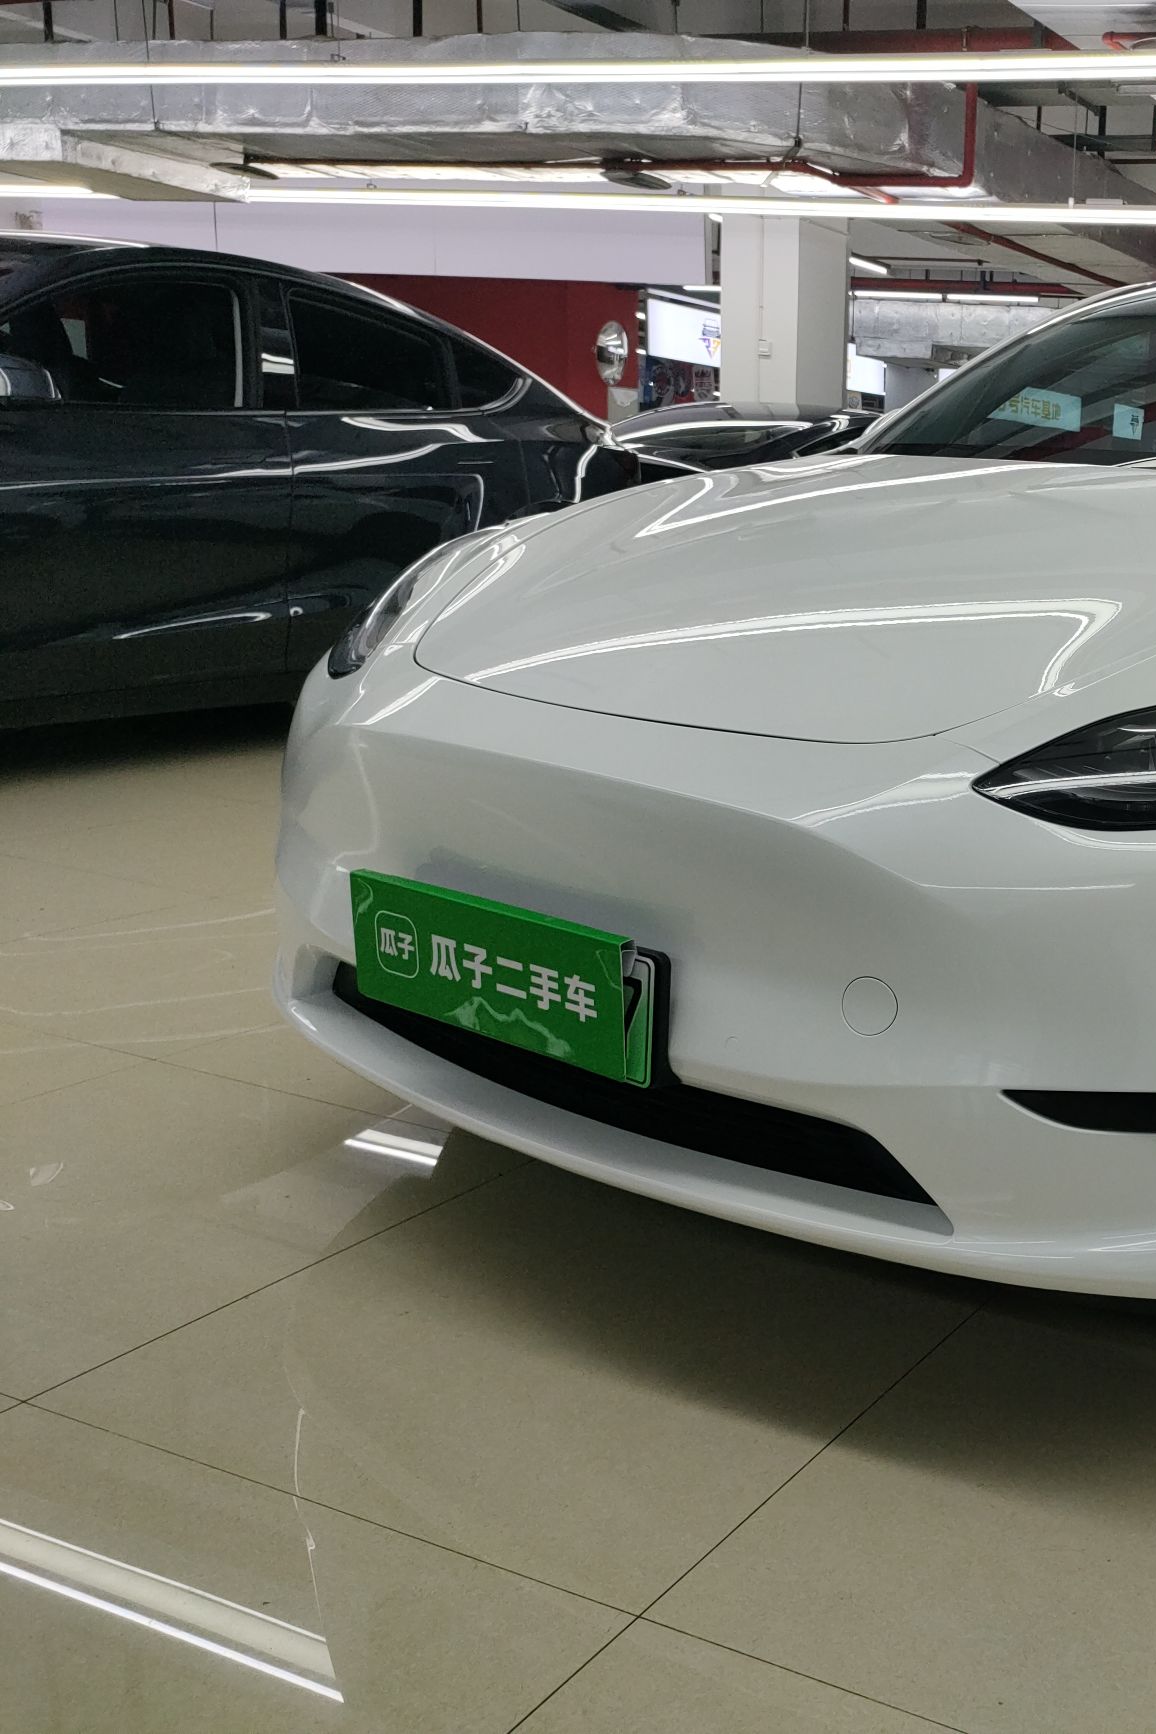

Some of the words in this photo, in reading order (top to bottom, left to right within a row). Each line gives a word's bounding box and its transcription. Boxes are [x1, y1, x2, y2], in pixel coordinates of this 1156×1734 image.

[380, 927, 415, 960] 瓜子
[430, 934, 597, 1023] 瓜子二手车
